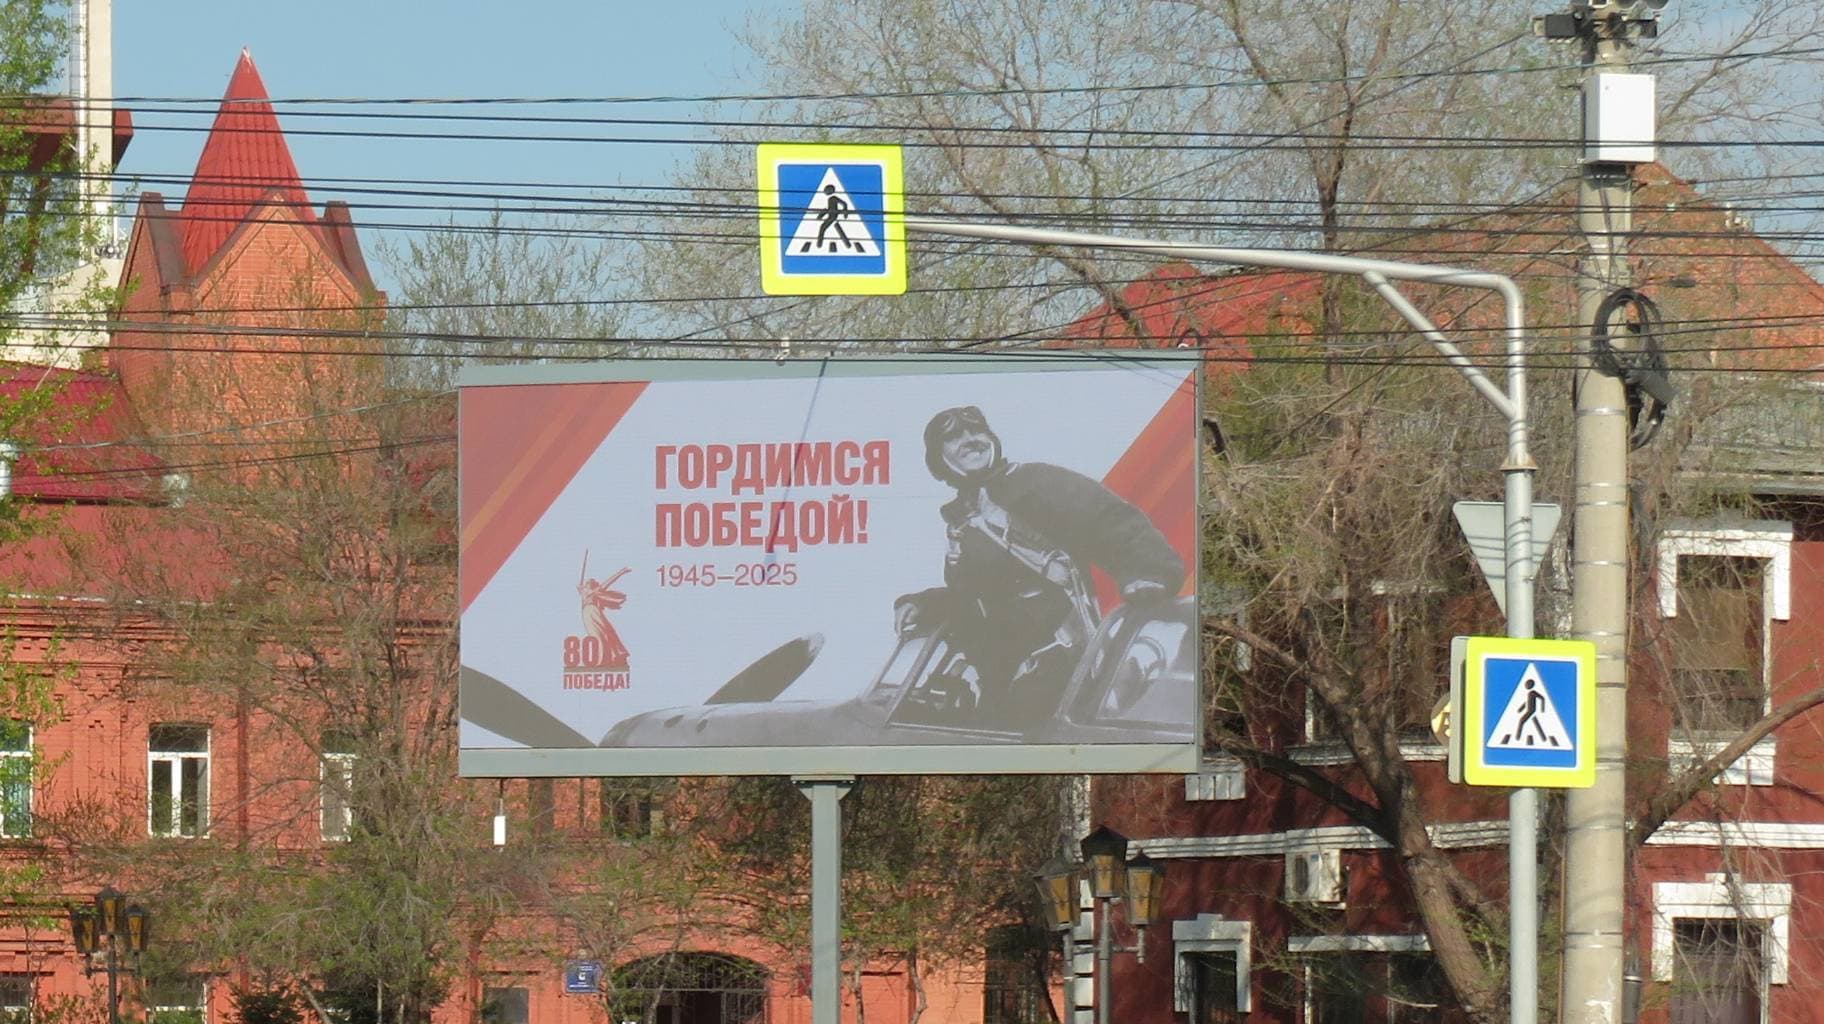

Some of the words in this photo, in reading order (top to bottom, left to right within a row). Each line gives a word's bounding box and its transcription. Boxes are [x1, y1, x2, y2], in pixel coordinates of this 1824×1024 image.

[655, 440, 890, 496] ГОРДИМСЯ
[655, 493, 869, 553] ПОБЕДОЙ!
[564, 635, 600, 667] 80
[563, 672, 631, 692] ПОБЕДА!
